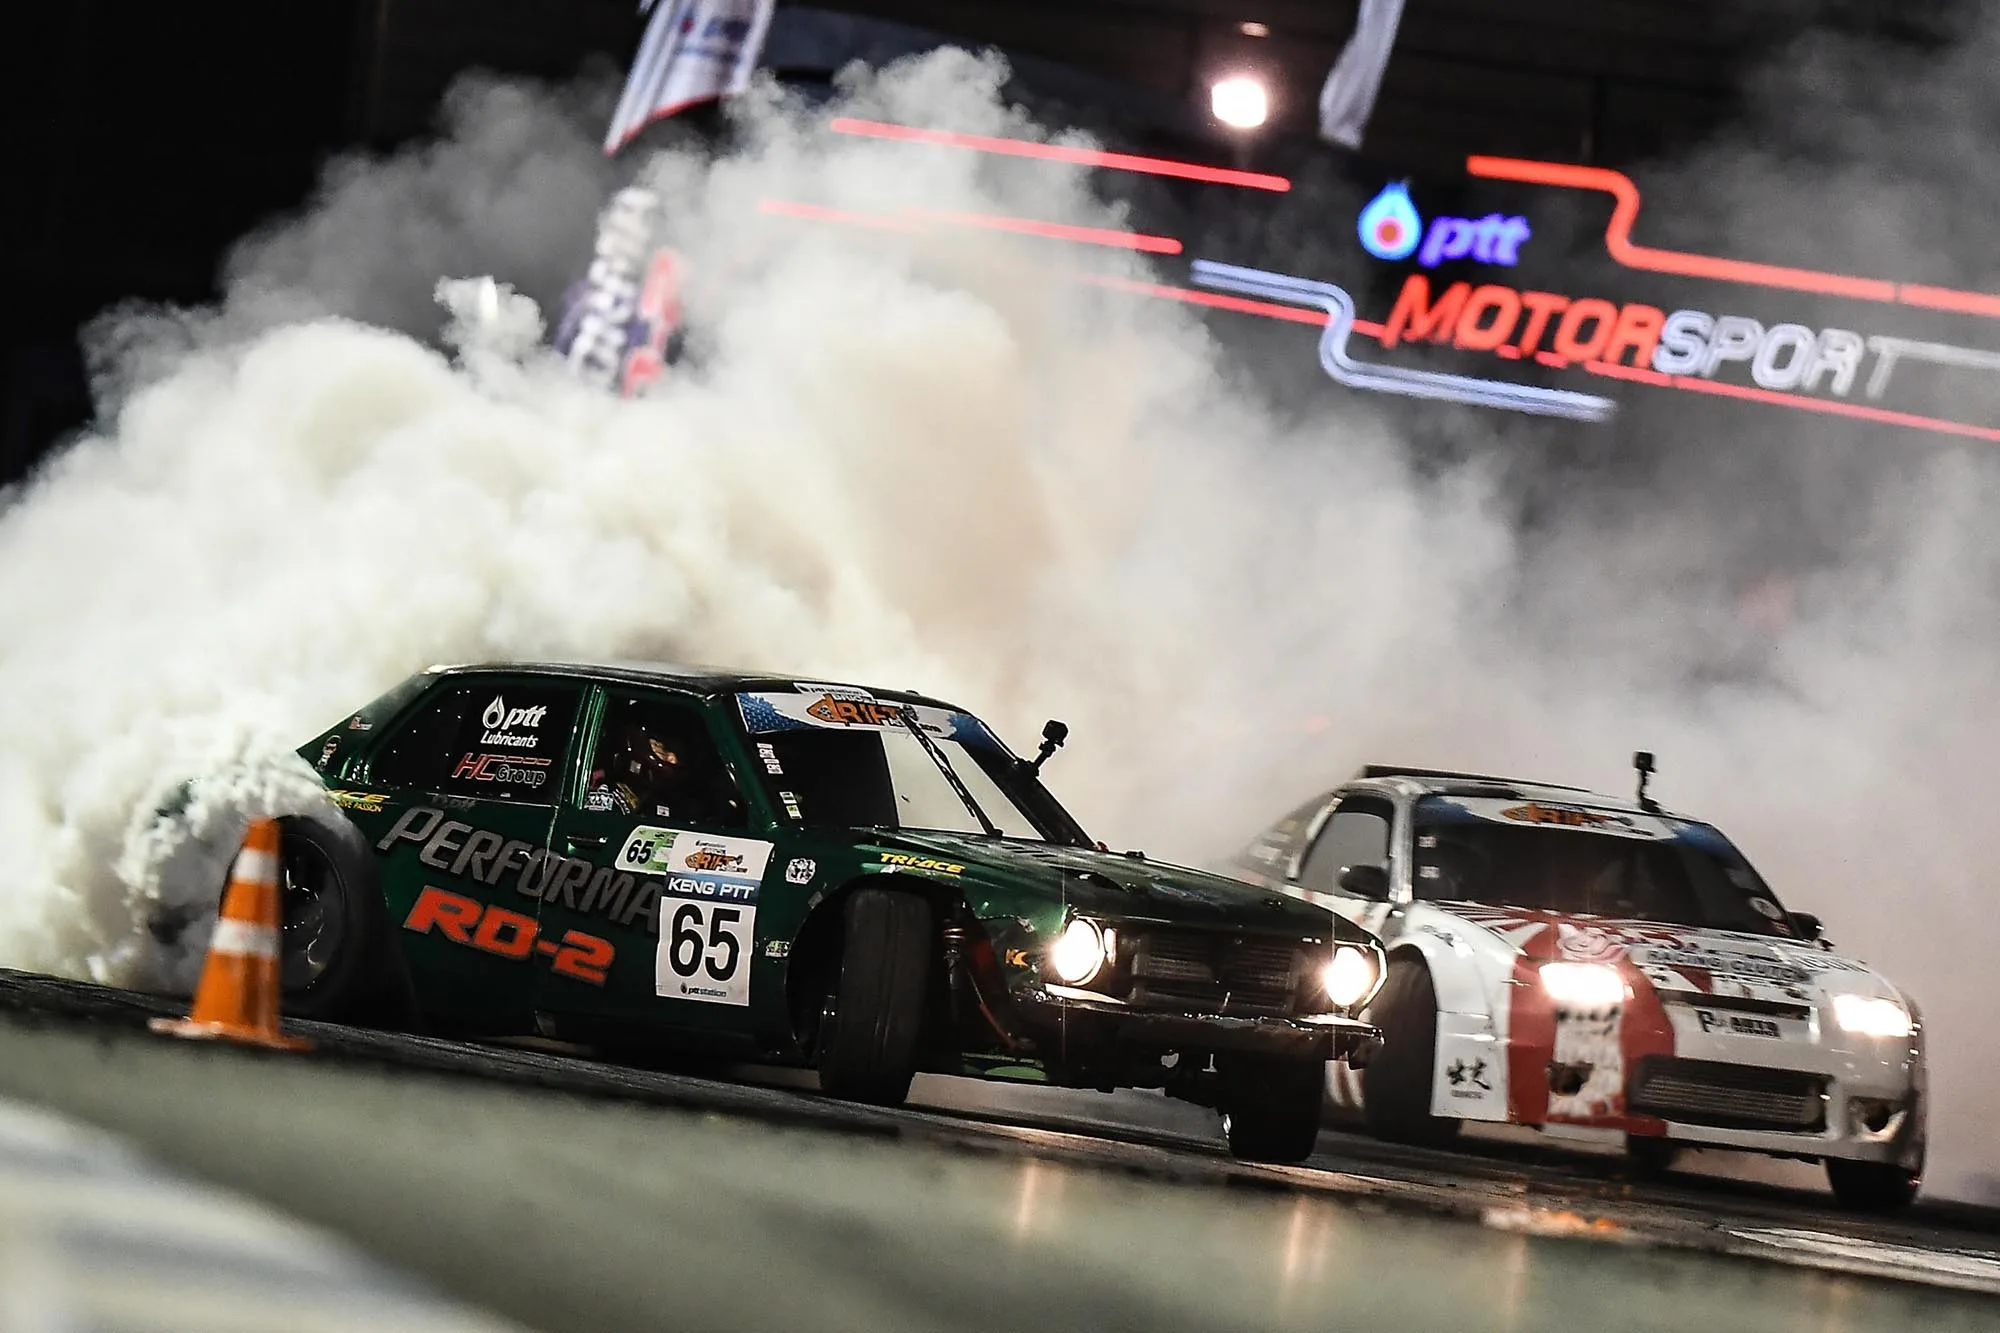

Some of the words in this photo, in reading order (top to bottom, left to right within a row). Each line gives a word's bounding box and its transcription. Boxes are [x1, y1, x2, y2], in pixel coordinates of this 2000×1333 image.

[1417, 213, 1531, 267] ptt
[1380, 273, 1906, 398] MOTORSPORT
[501, 705, 547, 730] ptt
[480, 730, 539, 748] Lubricants
[496, 763, 546, 789] Group
[376, 805, 662, 933] PERFORMA
[626, 839, 655, 865] 65
[668, 877, 715, 895] KENG
[719, 883, 755, 899] PTT
[403, 884, 616, 987] RD-2
[669, 903, 742, 981] 65
